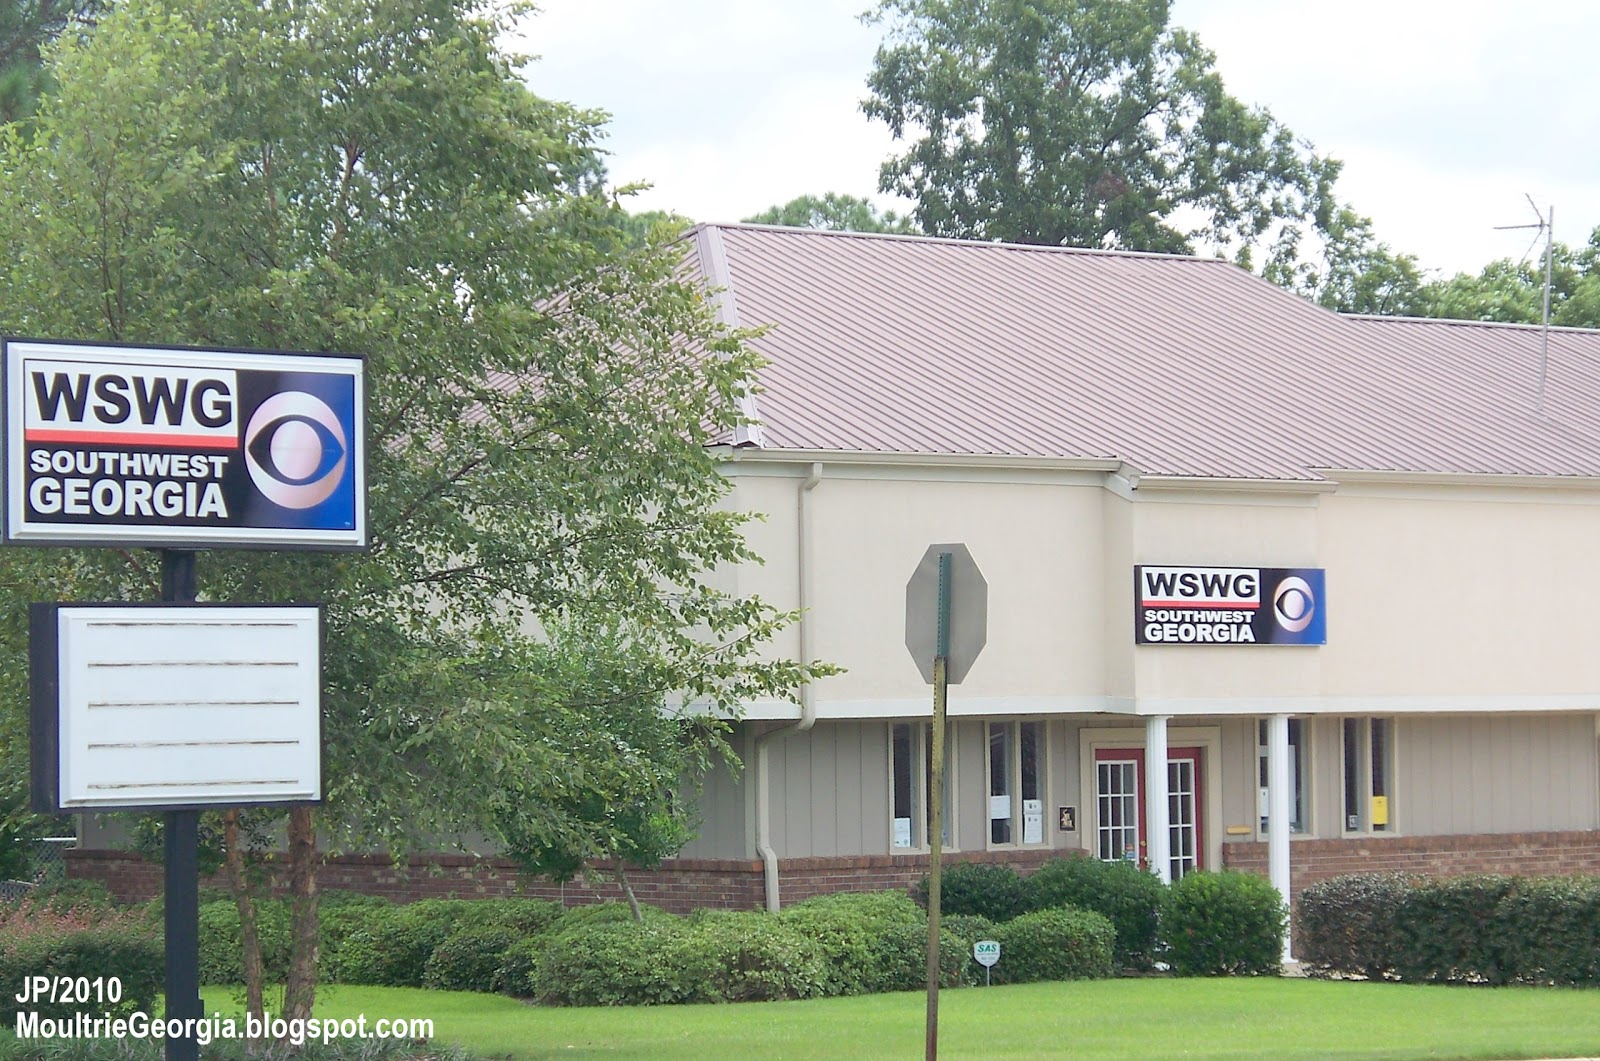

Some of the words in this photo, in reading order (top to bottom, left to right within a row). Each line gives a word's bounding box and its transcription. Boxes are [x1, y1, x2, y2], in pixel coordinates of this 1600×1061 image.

[31, 371, 233, 428] WSWG
[30, 449, 229, 479] SOUTHWEST
[29, 477, 228, 518] GEORGIA
[1146, 572, 1257, 597] WSWG
[1144, 610, 1255, 623] SOUTHWEST
[1144, 623, 1256, 643] GEORGIA
[978, 944, 997, 952] SAS
